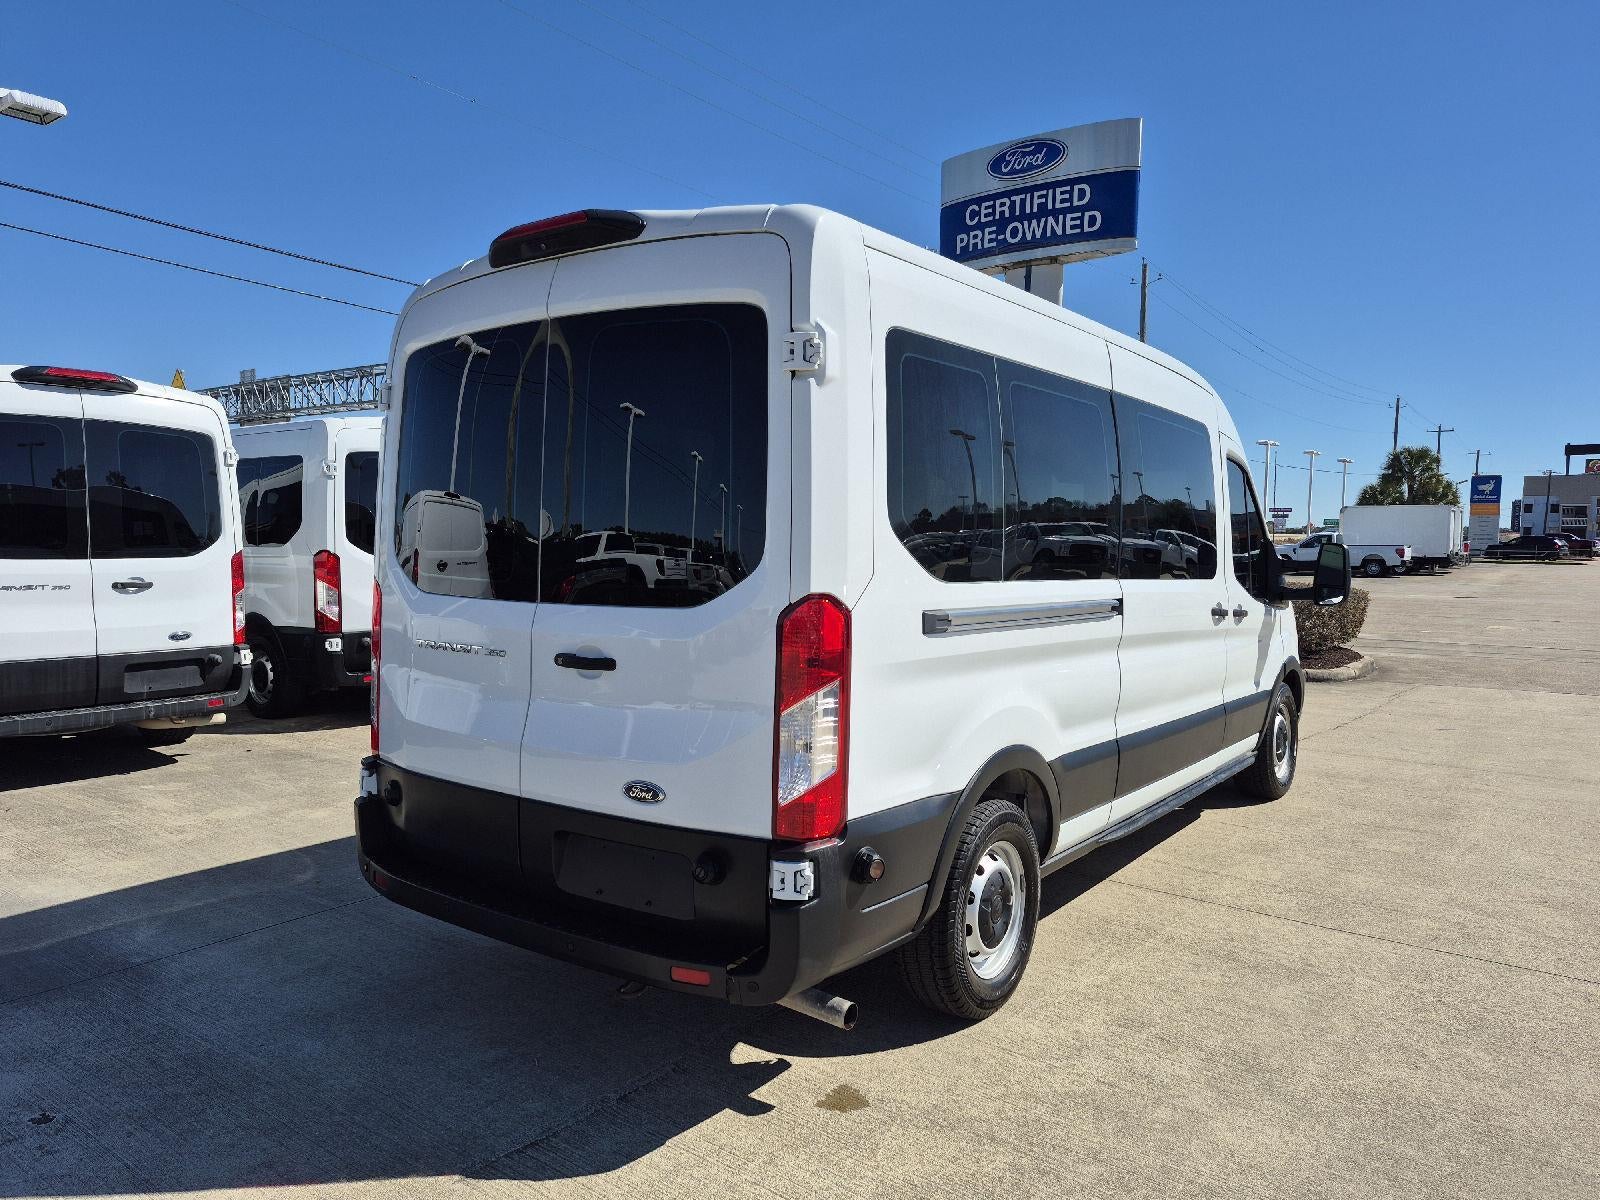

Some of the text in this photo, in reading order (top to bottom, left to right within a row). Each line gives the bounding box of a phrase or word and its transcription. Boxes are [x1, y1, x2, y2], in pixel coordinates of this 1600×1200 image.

[1001, 145, 1048, 173] Ford
[965, 183, 1091, 226] CERTIFIED
[956, 210, 1102, 254] PRE-OWNED
[416, 639, 483, 655] TRANSIT
[629, 785, 654, 800] Ford
